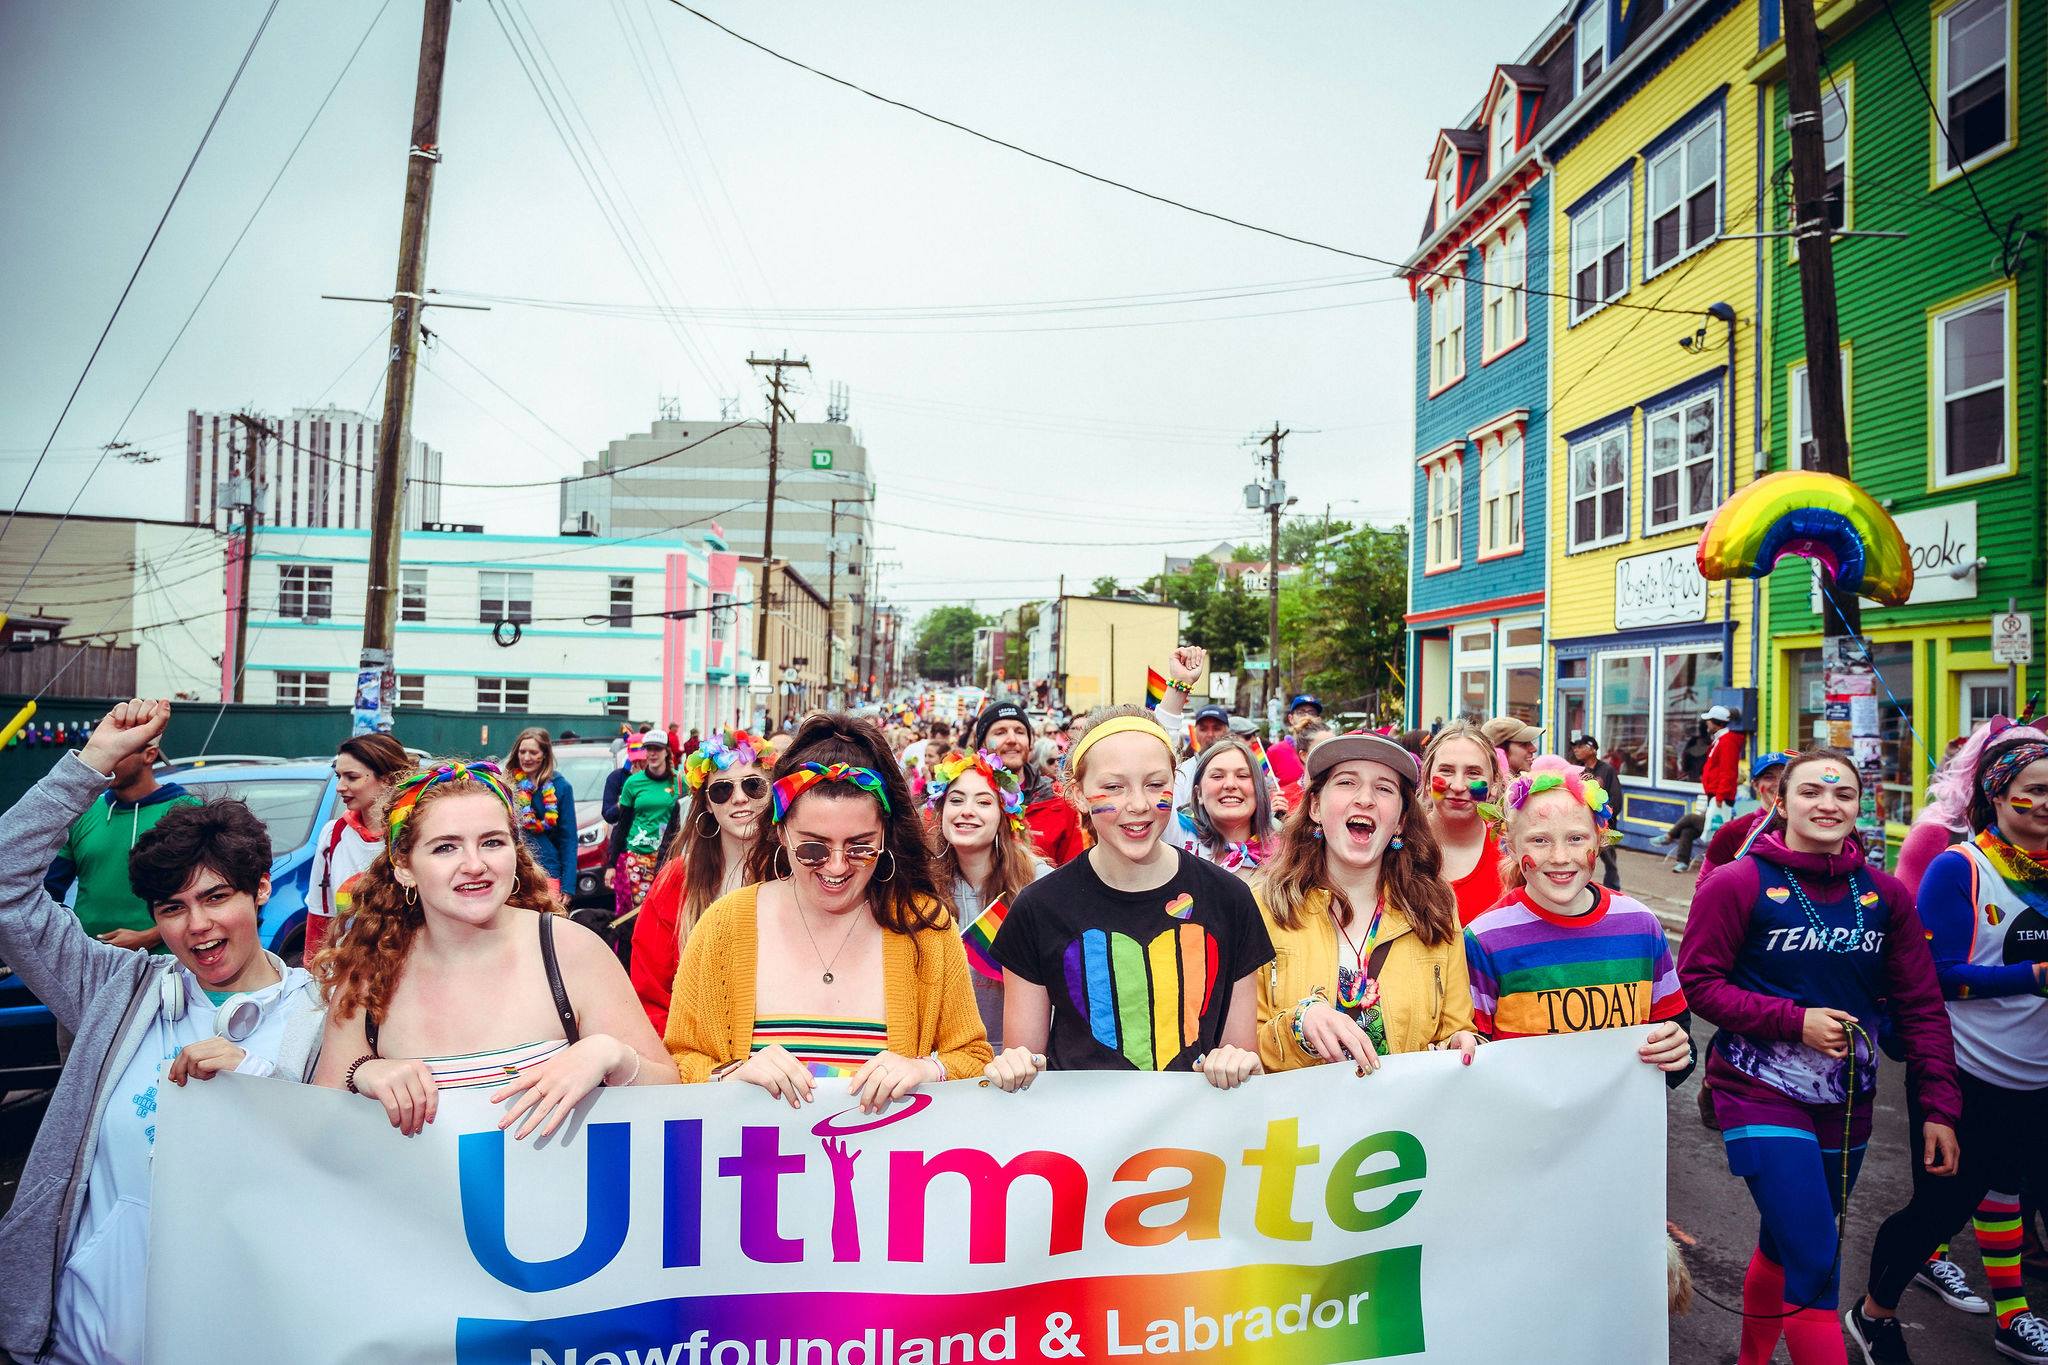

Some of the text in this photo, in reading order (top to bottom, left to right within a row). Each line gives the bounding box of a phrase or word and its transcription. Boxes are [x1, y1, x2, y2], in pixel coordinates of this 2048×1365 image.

[813, 452, 831, 466] TD
[1906, 519, 1968, 571] ook
[1537, 982, 1638, 1033] TODAY
[132, 1094, 157, 1112] SURRE
[457, 1093, 1427, 1294] Ultimate
[1039, 1311, 1086, 1359] &
[1106, 1291, 1369, 1356] Labrador
